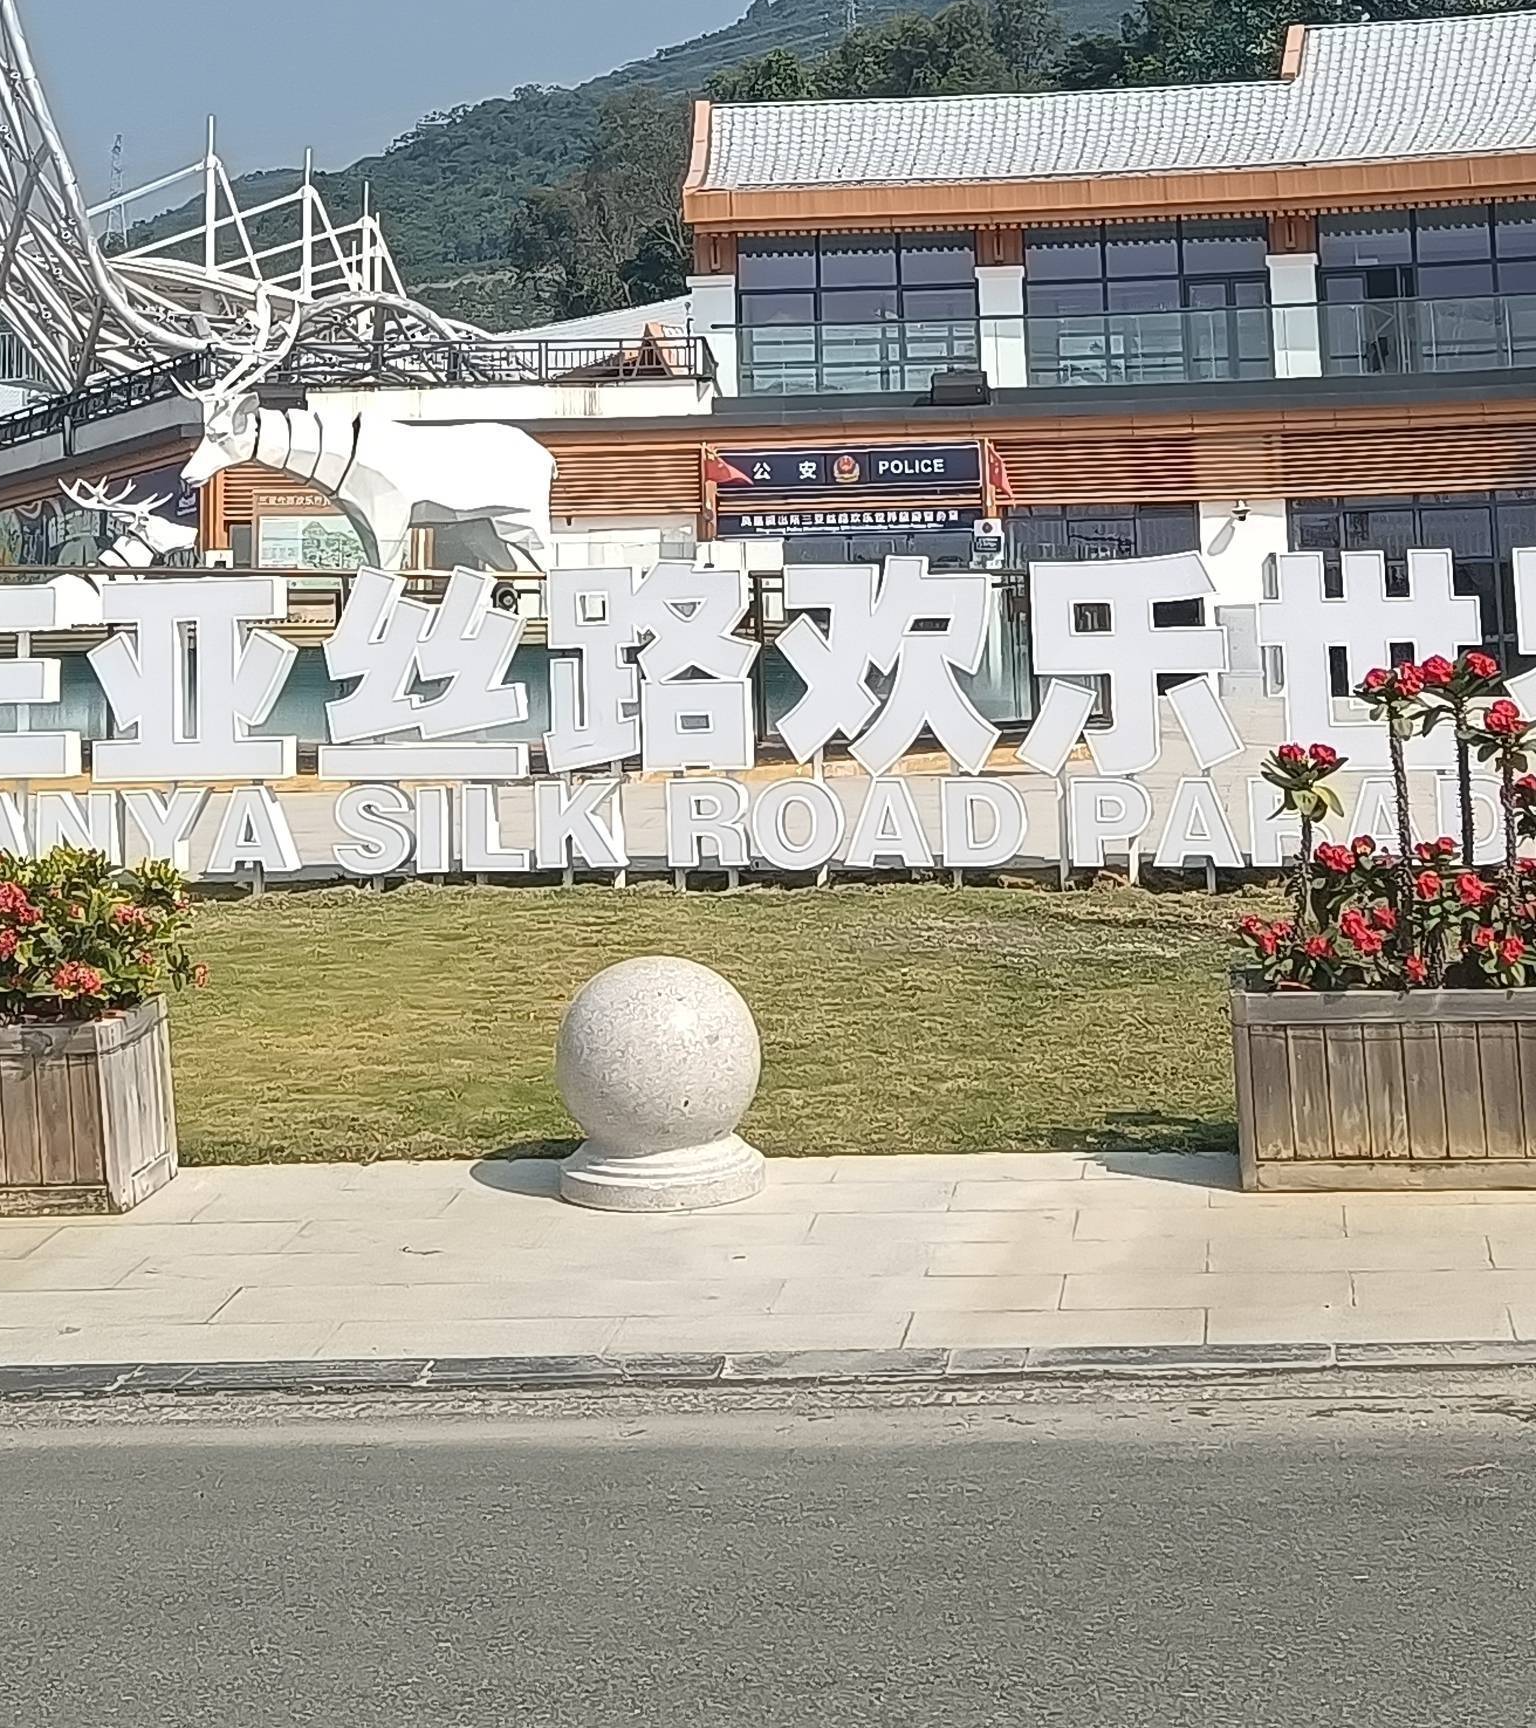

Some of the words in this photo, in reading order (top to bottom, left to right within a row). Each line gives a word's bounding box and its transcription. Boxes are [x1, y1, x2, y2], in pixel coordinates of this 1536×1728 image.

[752, 460, 818, 481] 公安
[877, 458, 945, 475] POLICE
[333, 777, 630, 875] SILK
[666, 772, 1028, 872] ROAD
